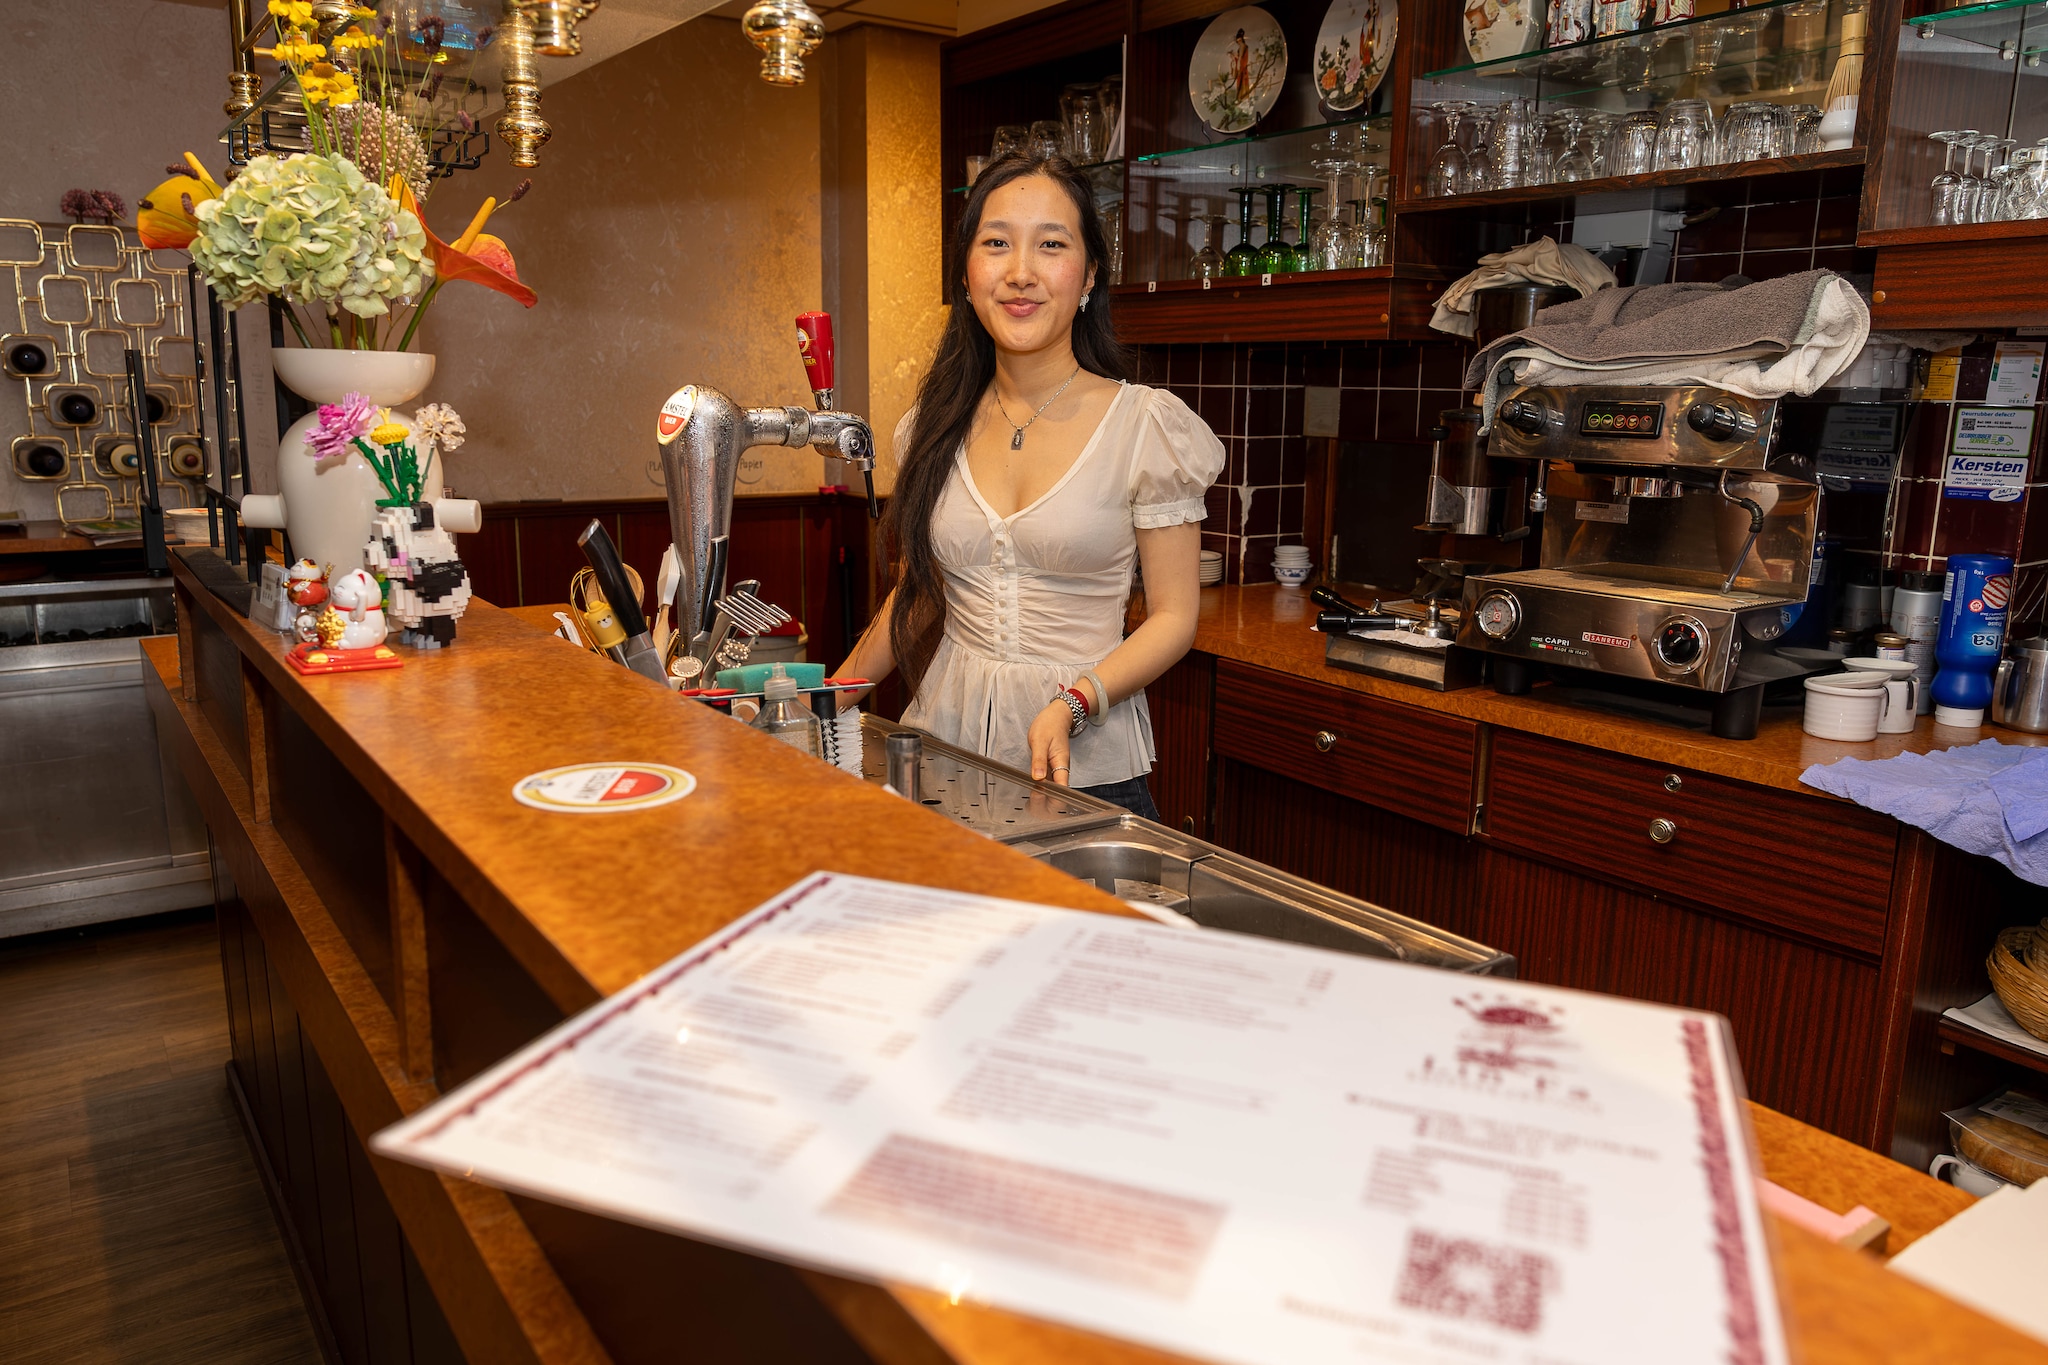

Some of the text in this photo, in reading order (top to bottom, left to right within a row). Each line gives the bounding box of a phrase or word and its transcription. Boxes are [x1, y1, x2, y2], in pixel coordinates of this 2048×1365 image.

[665, 402, 688, 417] AMSTEL
[1952, 458, 2024, 472] Kersten
[1545, 637, 1570, 647] CAPRI
[1590, 635, 1629, 647] SANREMO
